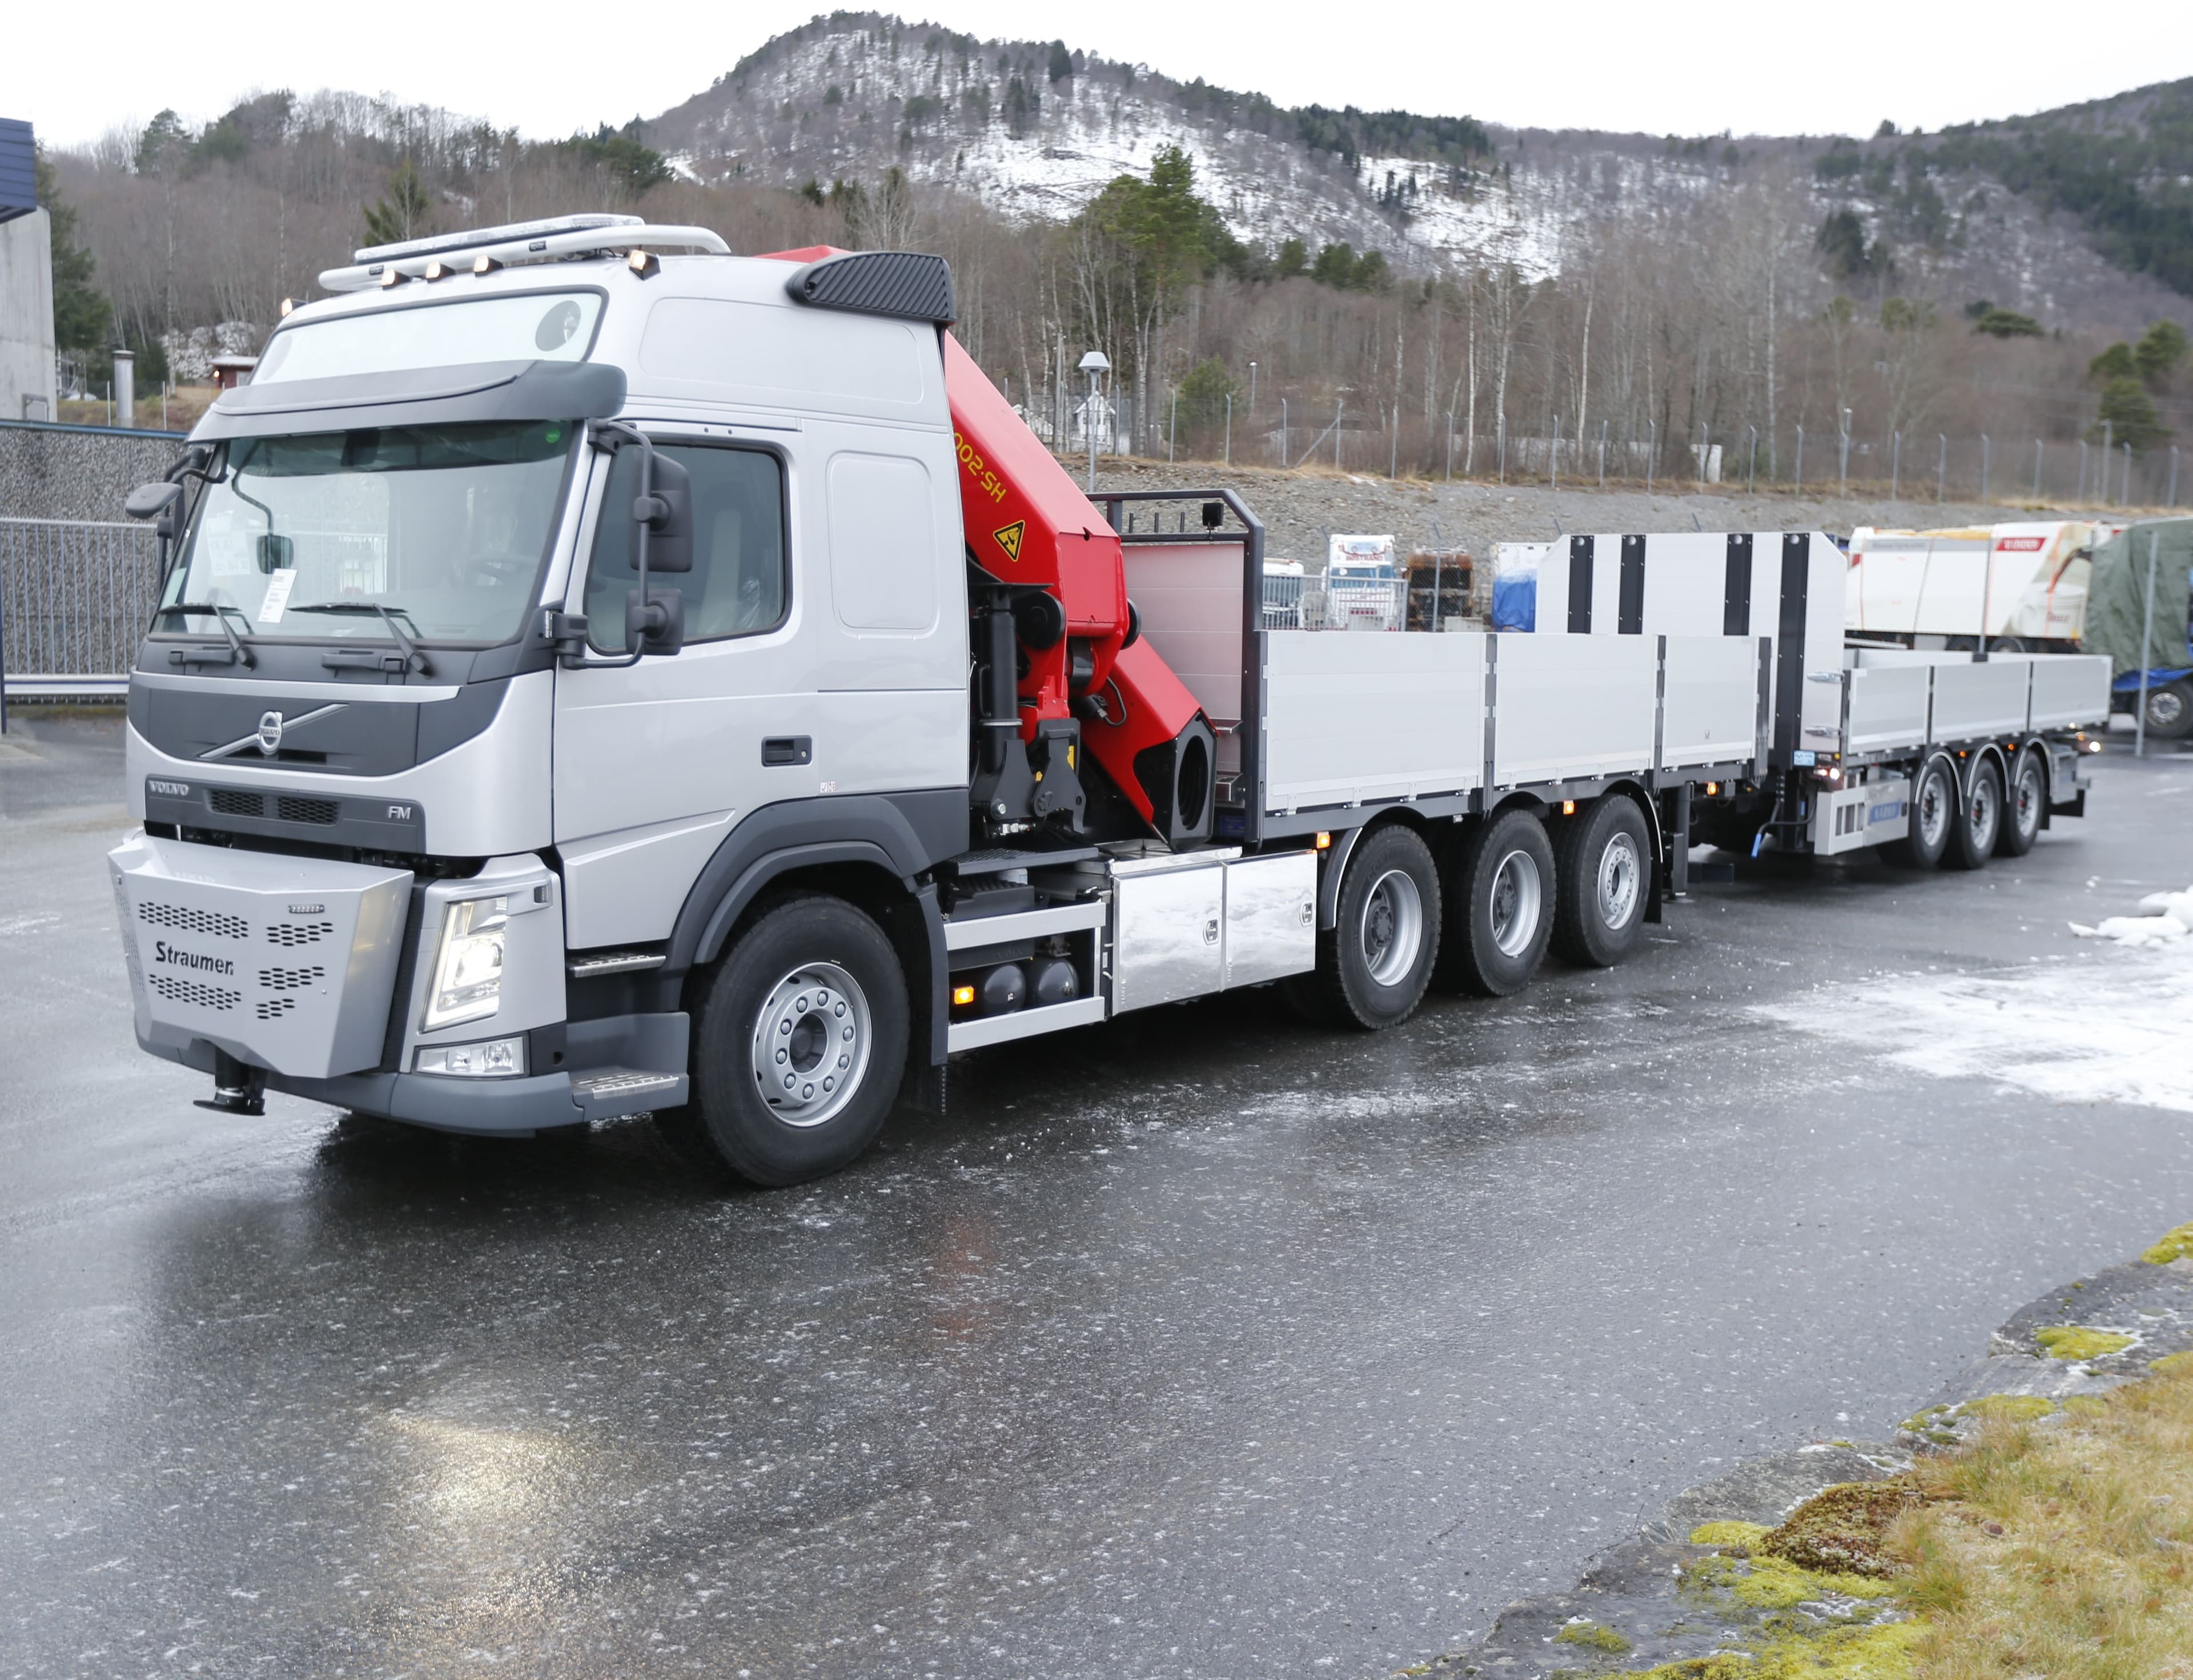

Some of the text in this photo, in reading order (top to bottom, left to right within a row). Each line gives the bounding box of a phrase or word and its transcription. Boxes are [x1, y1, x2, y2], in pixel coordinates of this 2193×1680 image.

[148, 780, 189, 796] VOLVO
[388, 806, 411, 819] FM
[156, 941, 234, 975] Straumen
